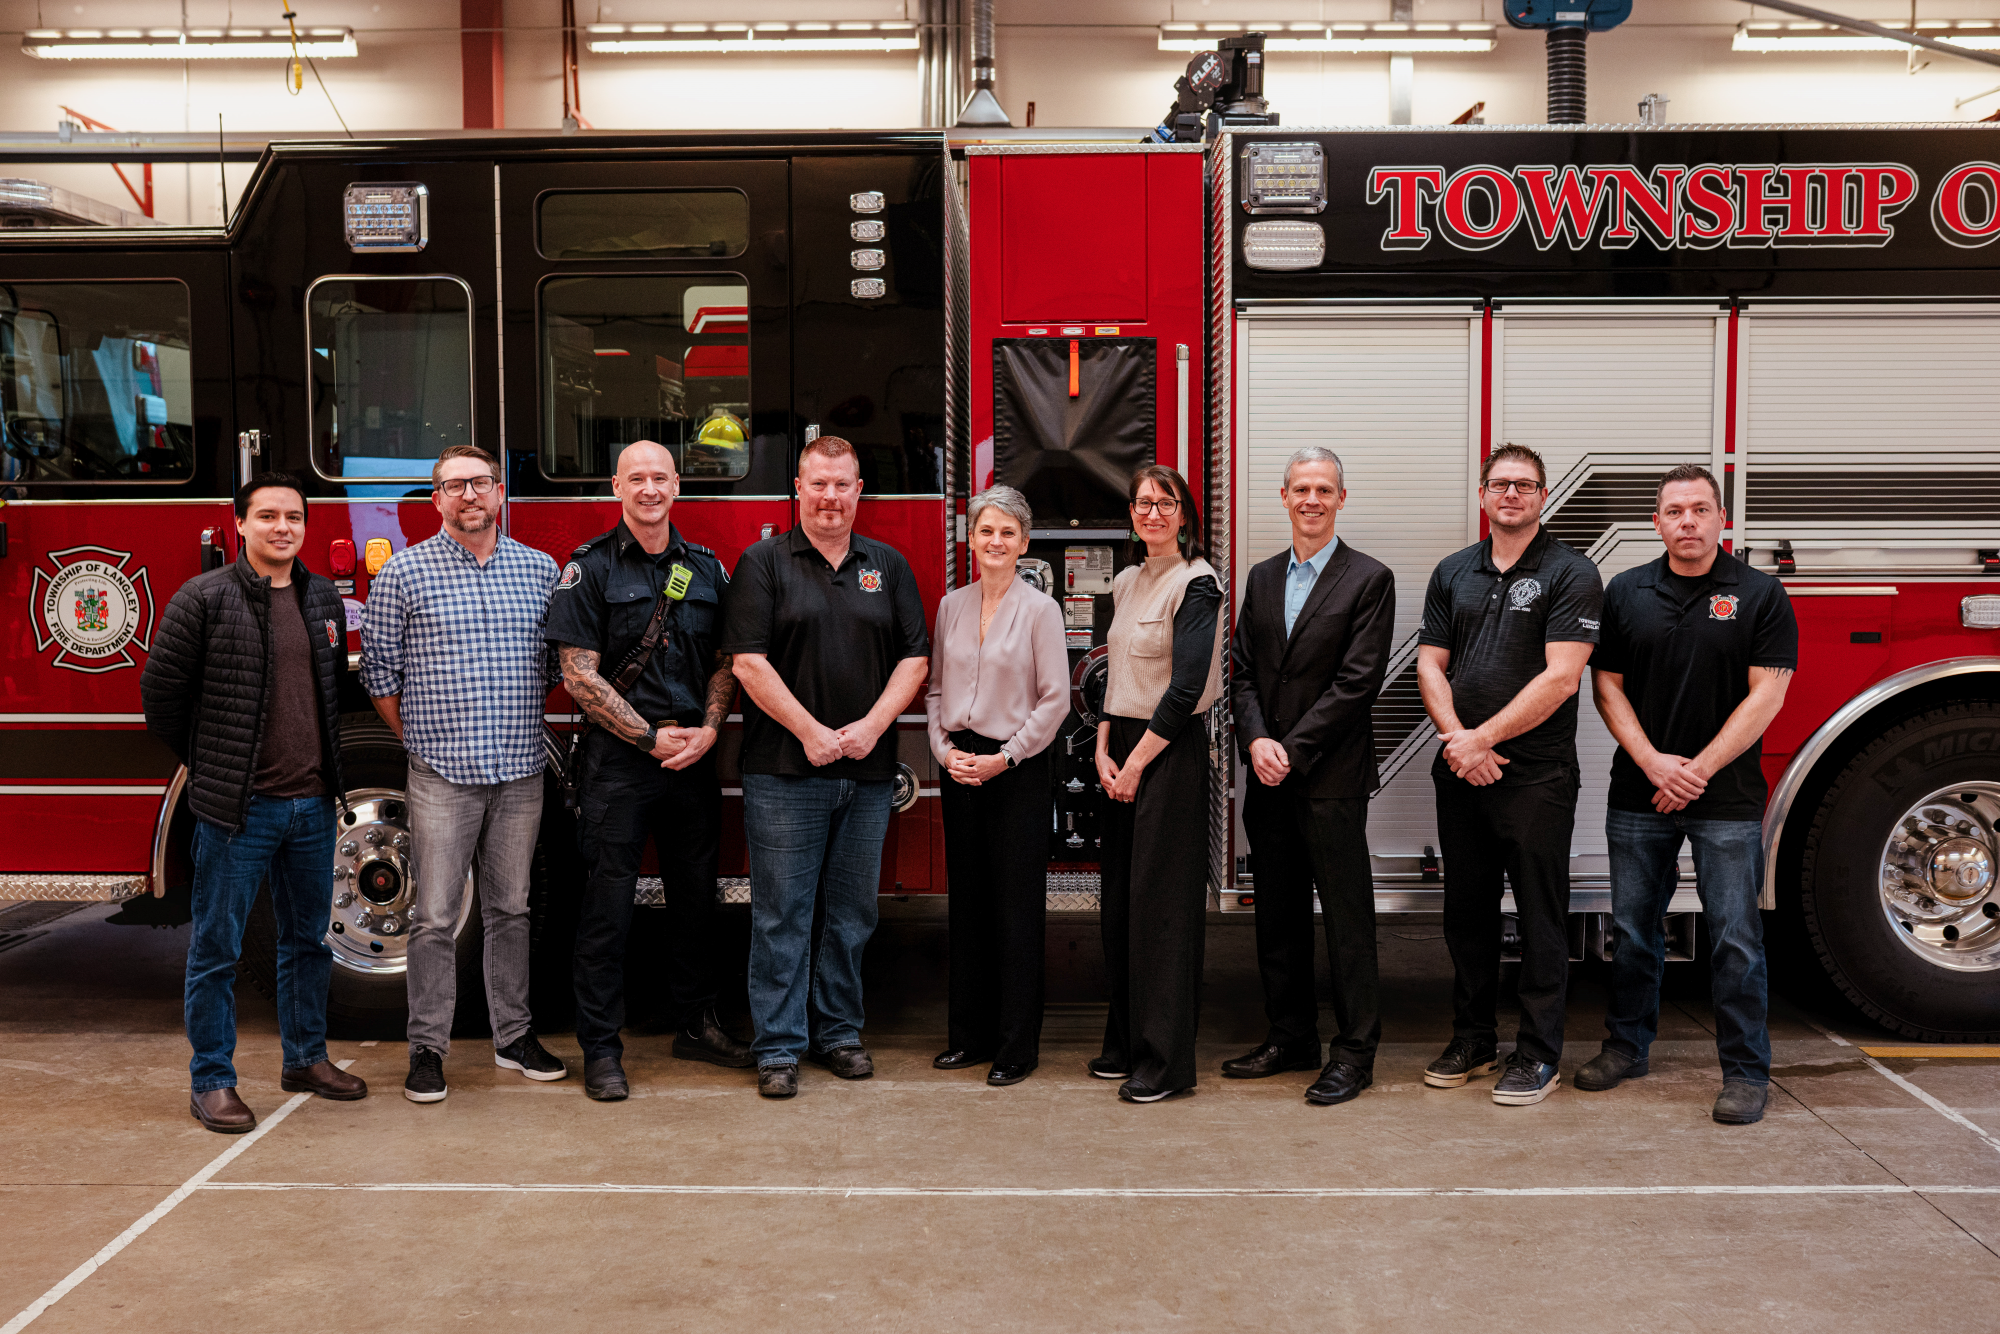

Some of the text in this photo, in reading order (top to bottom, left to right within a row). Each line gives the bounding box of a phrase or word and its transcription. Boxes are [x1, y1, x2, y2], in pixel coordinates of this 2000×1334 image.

[1191, 54, 1219, 85] FLEX
[1366, 159, 2000, 251] TOWNSHIP O
[47, 563, 138, 614] TOWNSHIP OF LANGLEY
[50, 621, 135, 656] FIRE DEPARTMENT
